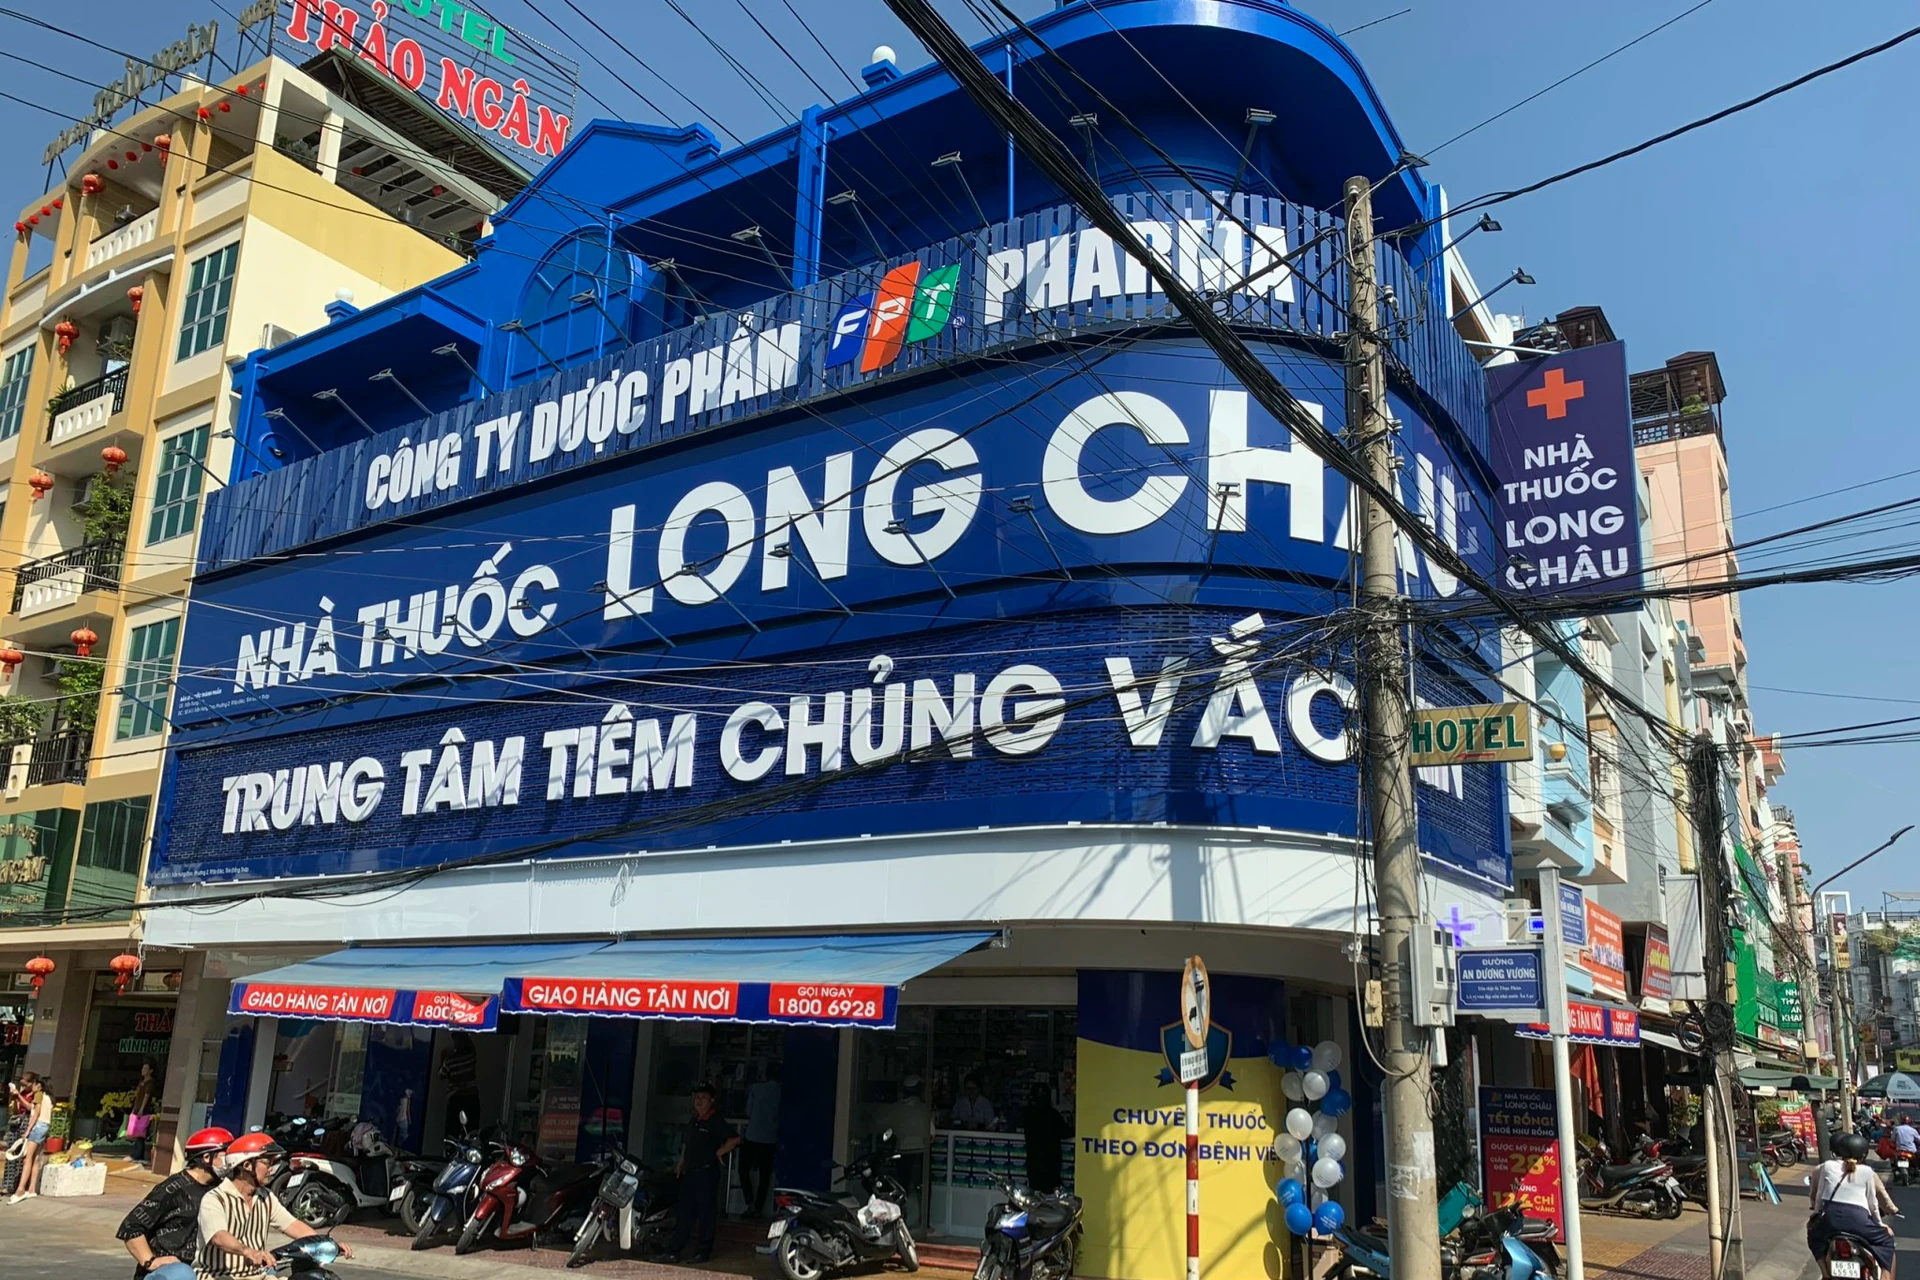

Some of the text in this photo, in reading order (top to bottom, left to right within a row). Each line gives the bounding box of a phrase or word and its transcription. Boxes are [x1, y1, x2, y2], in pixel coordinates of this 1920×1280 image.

[386, 0, 516, 65] OTEL
[286, 0, 570, 157] THẢO NGÂN
[984, 219, 1296, 326] PHARMA
[833, 284, 953, 351] FPT
[366, 311, 801, 510] CÔNG TY DƯỢC PHẨM
[1524, 433, 1594, 470] NHÀ
[1504, 461, 1618, 505] THUỐC
[1506, 505, 1625, 548] LONG
[234, 596, 338, 694] NHÀ
[357, 541, 560, 669] THUỐC
[604, 428, 982, 622] LONG
[1504, 544, 1629, 590] CHÂU
[222, 756, 385, 835] TRUNG
[401, 727, 525, 816] TÂM
[542, 704, 696, 801] TIÊM
[719, 655, 1066, 782] CHỦNG
[1104, 612, 1358, 762] VẮC
[1412, 714, 1526, 754] HOTEL
[1463, 966, 1536, 979] AN DƯƠNG VƯƠNG
[1482, 957, 1514, 966] ĐƯỜNG
[248, 988, 388, 1015] GIAO HÀNG TẬN NƠI
[528, 982, 729, 1012] GIAO HÀNG TẬN NƠI
[797, 986, 855, 998] GỌI NGAY
[778, 998, 876, 1017] 1800 6928
[1576, 1007, 1589, 1033] TẬN
[119, 1036, 168, 1054] KÍNH CH
[1505, 1102, 1527, 1110] LONG
[1529, 1101, 1552, 1110] CHÂU
[1519, 1092, 1541, 1101] THUỐC
[1113, 1107, 1266, 1130] CHUYÊ THUỐC
[1488, 1111, 1510, 1124] TẾT
[1512, 1127, 1530, 1136] NHƯ
[1532, 1126, 1554, 1137] RỒNG
[1081, 1137, 1137, 1156] THEO
[1199, 1141, 1250, 1164] BỆNH
[1255, 1145, 1281, 1165] VIỆ
[1515, 1143, 1528, 1151] MỸ
[1530, 1143, 1553, 1153] PHẨM
[1509, 1153, 1556, 1175] 28%
[1510, 1182, 1537, 1193] TÚNG
[1535, 1204, 1555, 1213] VÀNG
